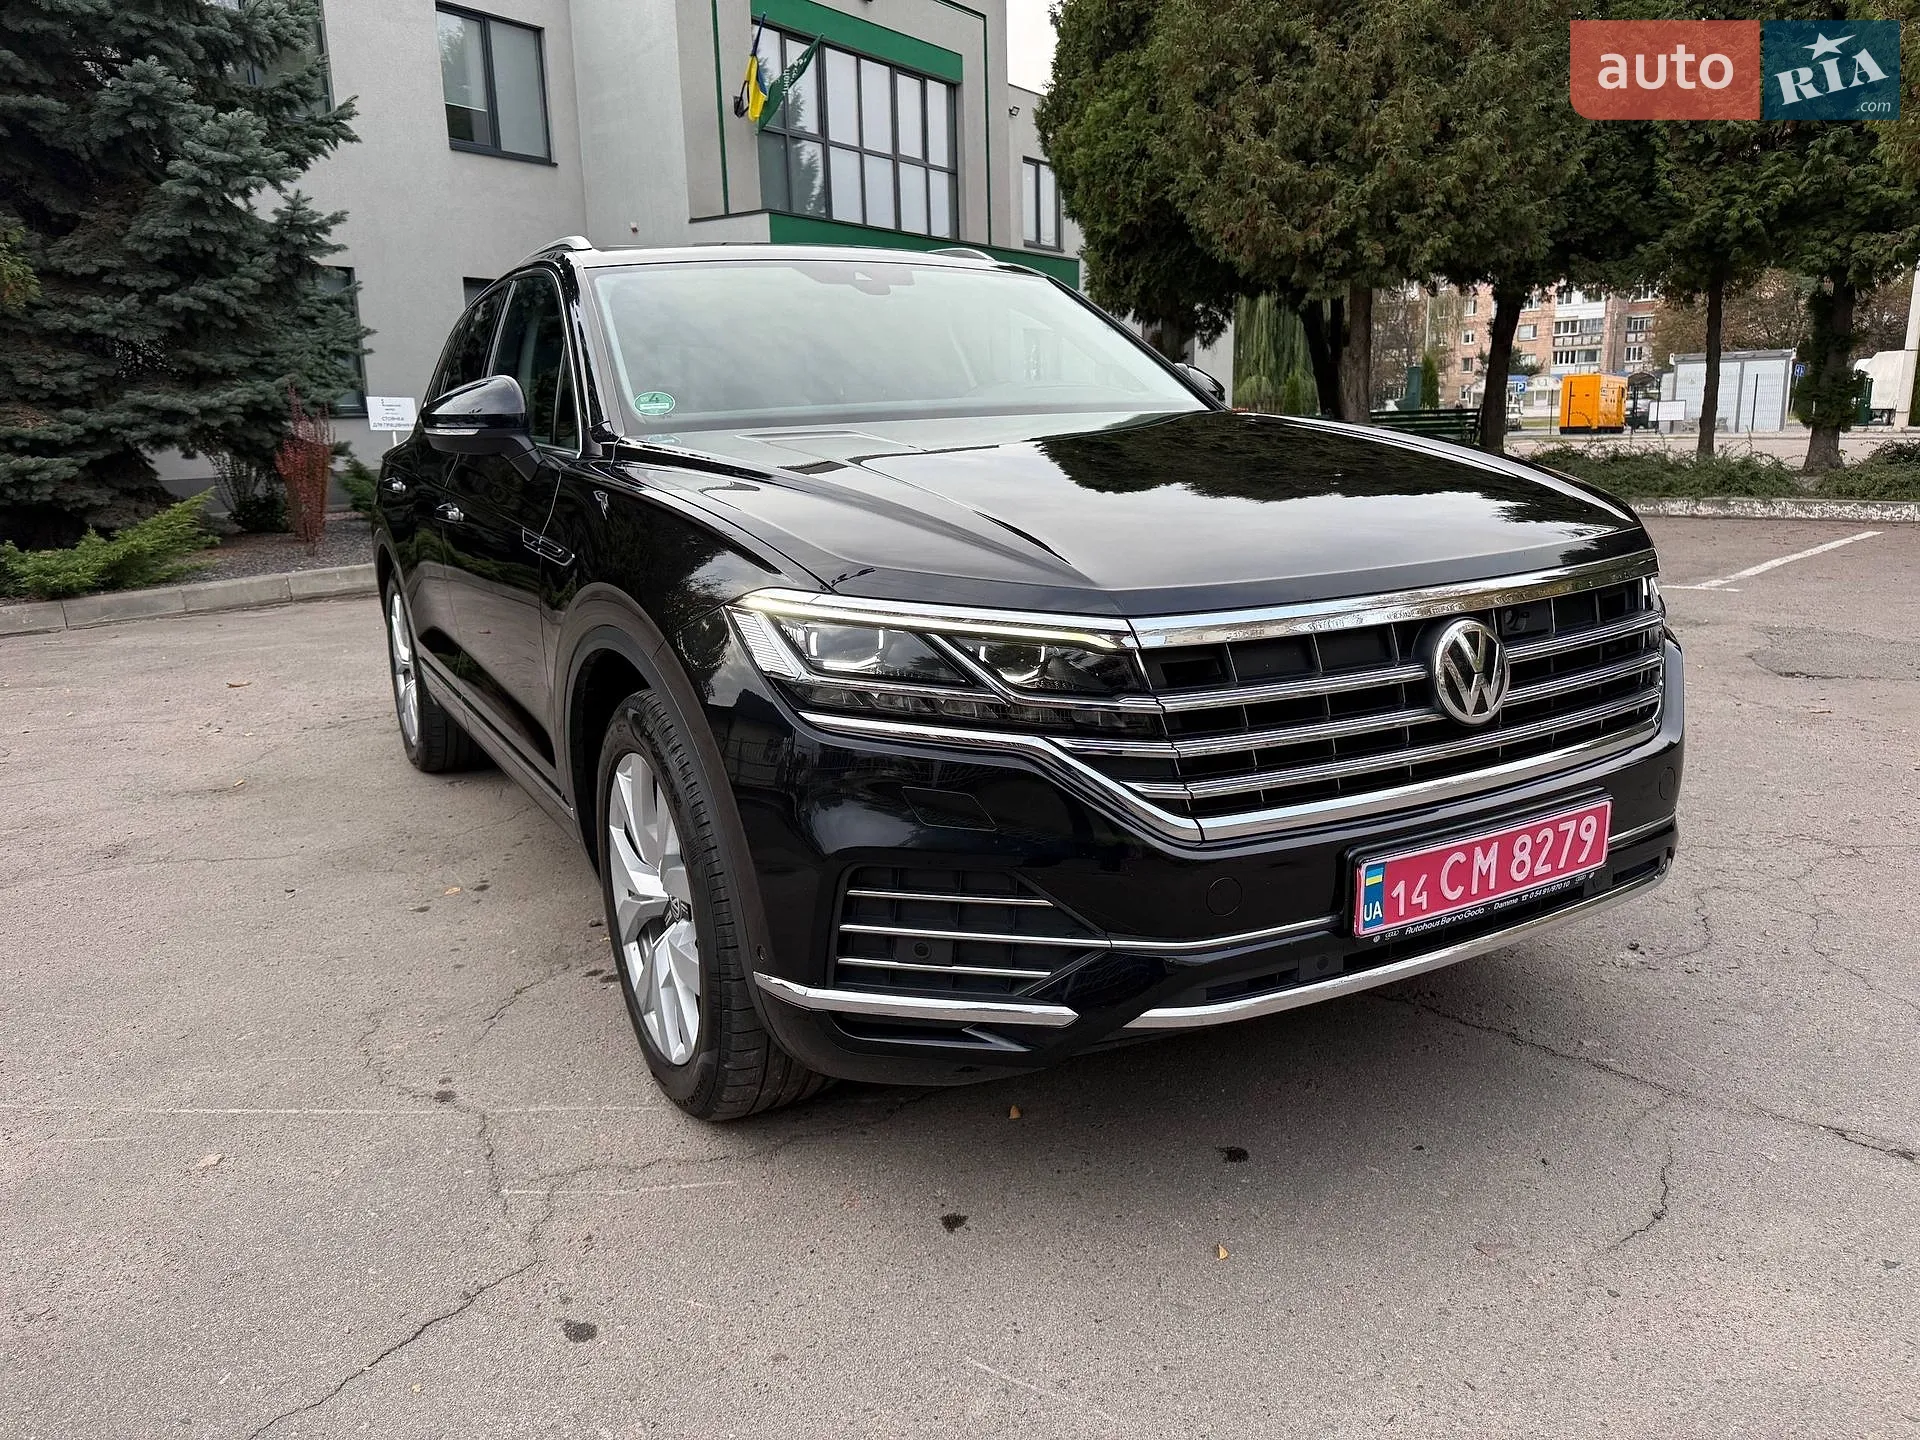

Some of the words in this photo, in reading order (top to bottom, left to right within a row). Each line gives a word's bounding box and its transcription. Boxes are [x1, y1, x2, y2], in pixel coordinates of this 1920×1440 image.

[1364, 901, 1383, 921] UA
[1391, 873, 1428, 916] 14
[1440, 842, 1499, 901] CM
[1509, 815, 1598, 883] 8279
